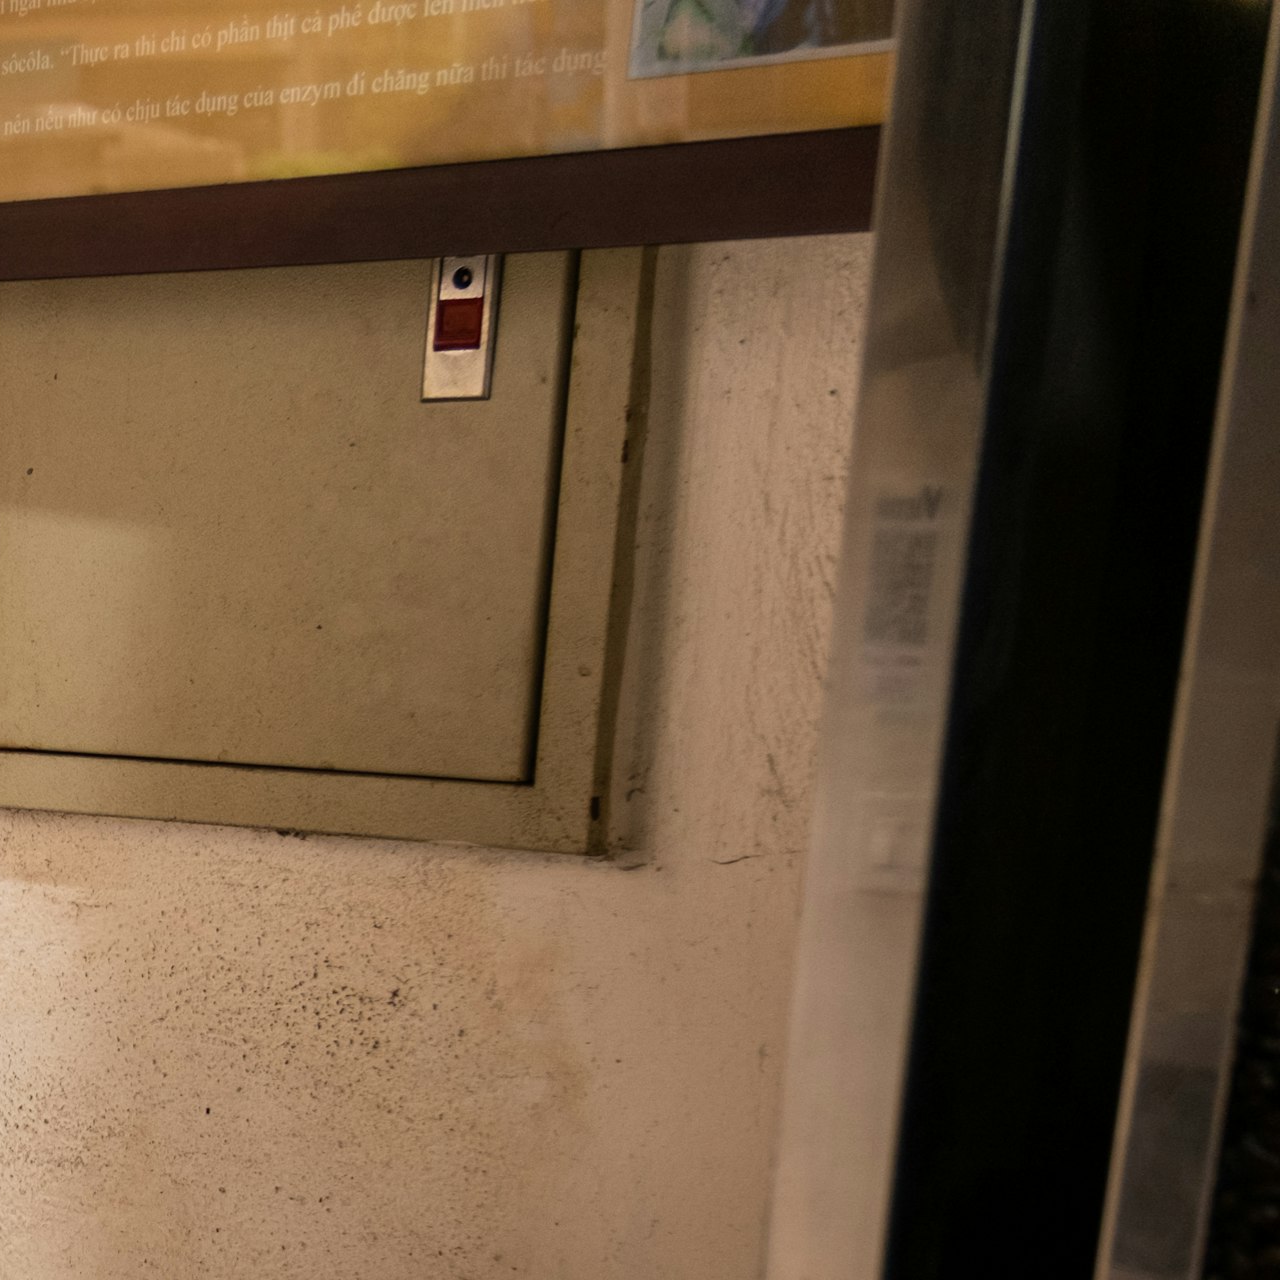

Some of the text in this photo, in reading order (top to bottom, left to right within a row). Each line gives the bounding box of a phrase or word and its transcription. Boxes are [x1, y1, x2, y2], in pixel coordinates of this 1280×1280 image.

[114, 43, 129, 61] ra
[192, 26, 211, 49] có
[216, 14, 260, 51] phần
[266, 14, 295, 40] thịt
[328, 4, 362, 37] phê
[68, 107, 98, 129] như
[102, 102, 122, 124] có
[126, 98, 160, 123] chịu
[166, 95, 190, 117] tác
[195, 90, 238, 117] dụng
[243, 85, 274, 108] của
[279, 81, 340, 107] enzym
[436, 62, 474, 87] nữa
[515, 51, 546, 78] tác
[552, 48, 608, 77] dụng
